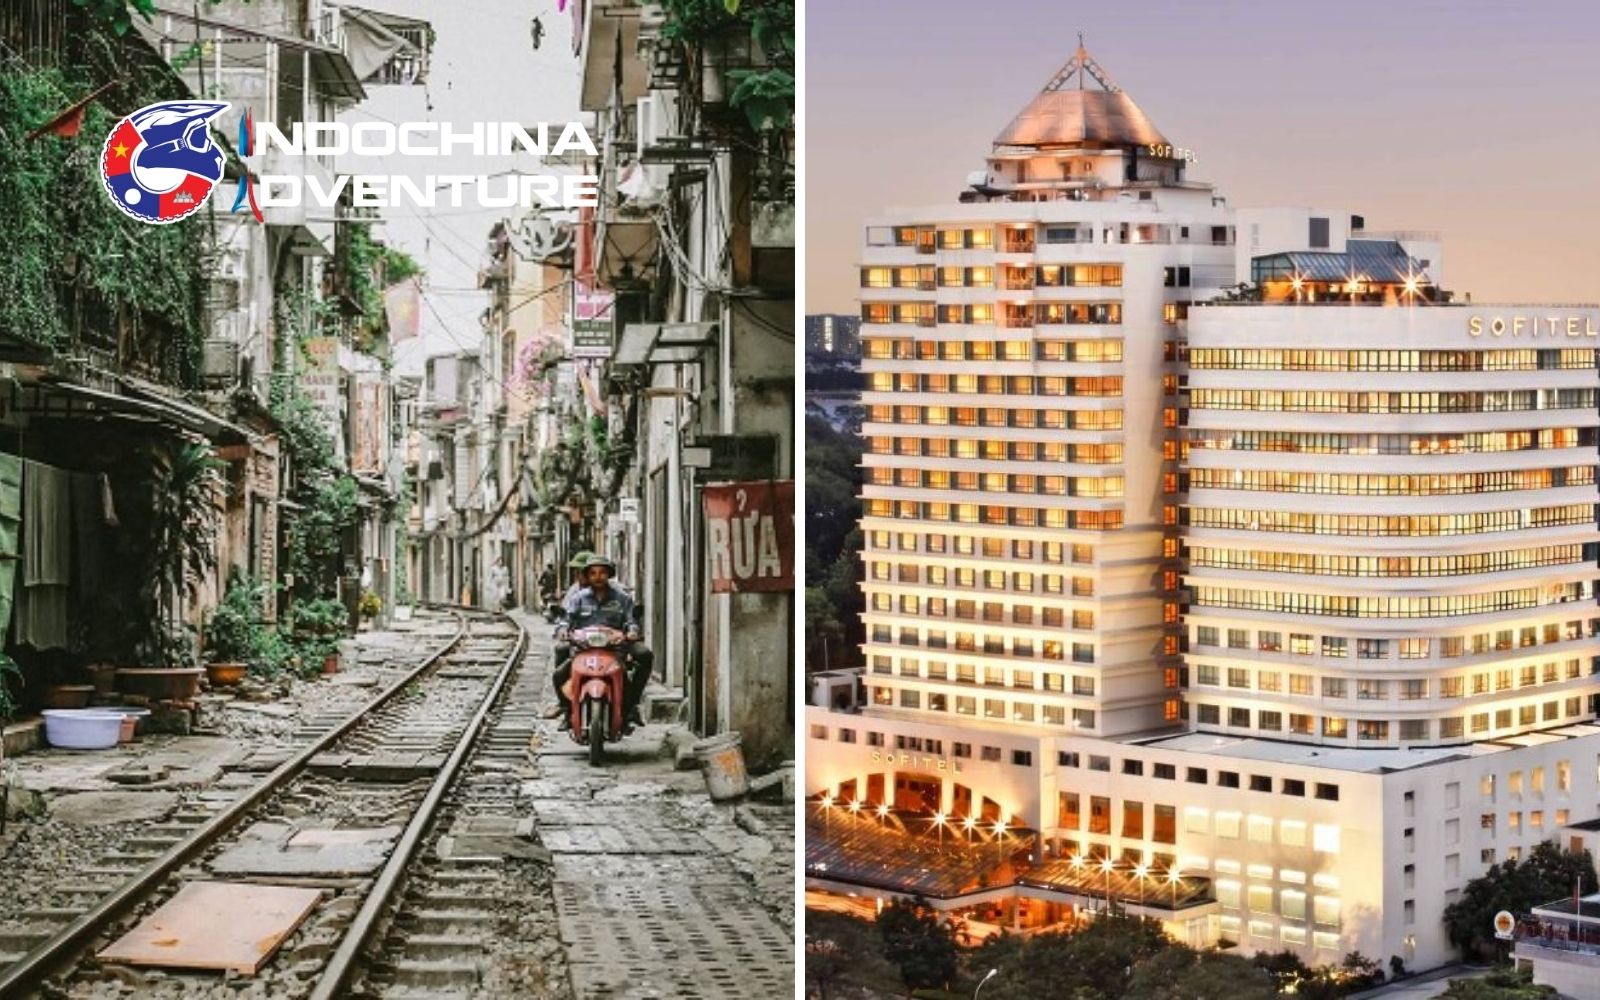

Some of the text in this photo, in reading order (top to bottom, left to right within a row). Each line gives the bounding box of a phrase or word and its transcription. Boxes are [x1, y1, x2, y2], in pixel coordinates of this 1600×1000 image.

[1149, 144, 1198, 163] SOFTEL
[1469, 316, 1598, 336] SOFITEL
[710, 488, 781, 579] RỬA
[872, 751, 961, 776] SOFITEL
